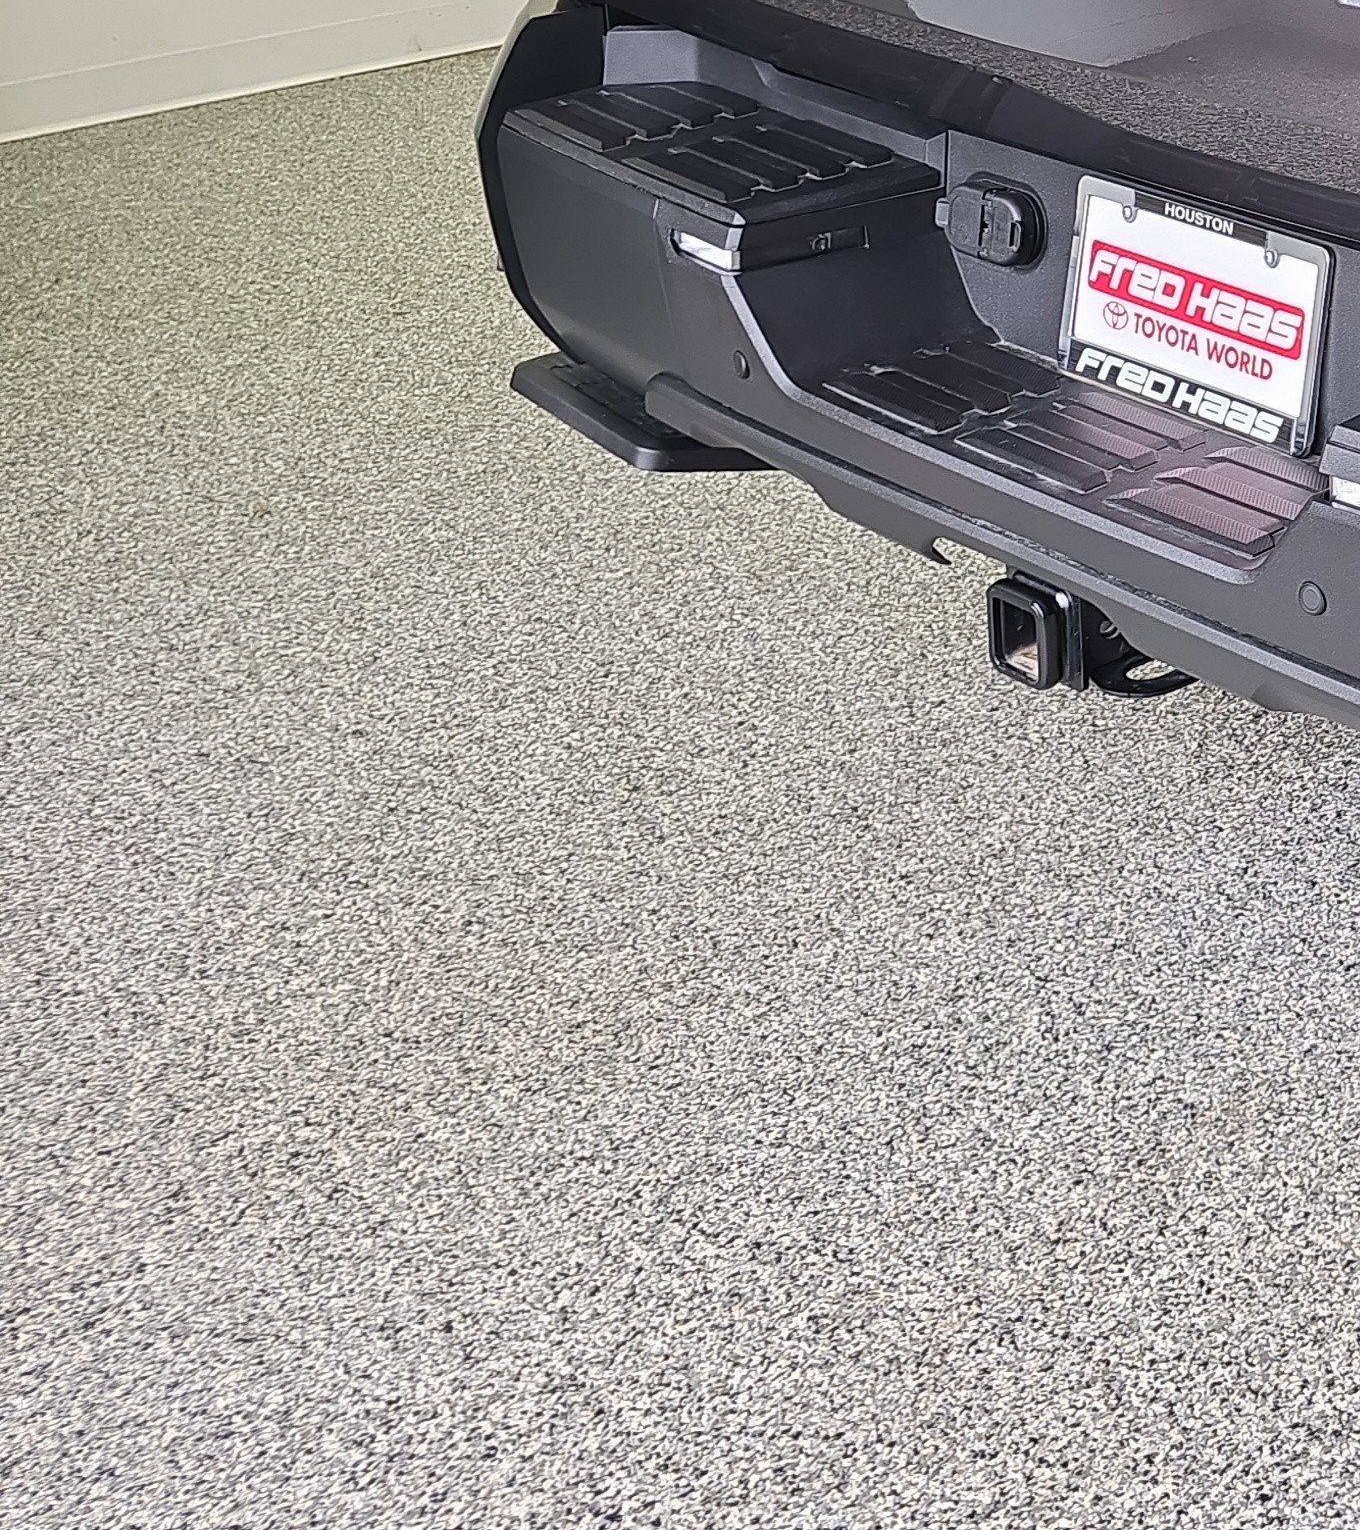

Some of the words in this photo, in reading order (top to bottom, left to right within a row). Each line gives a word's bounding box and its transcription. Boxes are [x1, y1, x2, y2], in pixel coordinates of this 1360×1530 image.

[1164, 202, 1234, 236] HOUSTON
[1133, 312, 1199, 357] TOYOTA
[1206, 337, 1273, 381] WORLD
